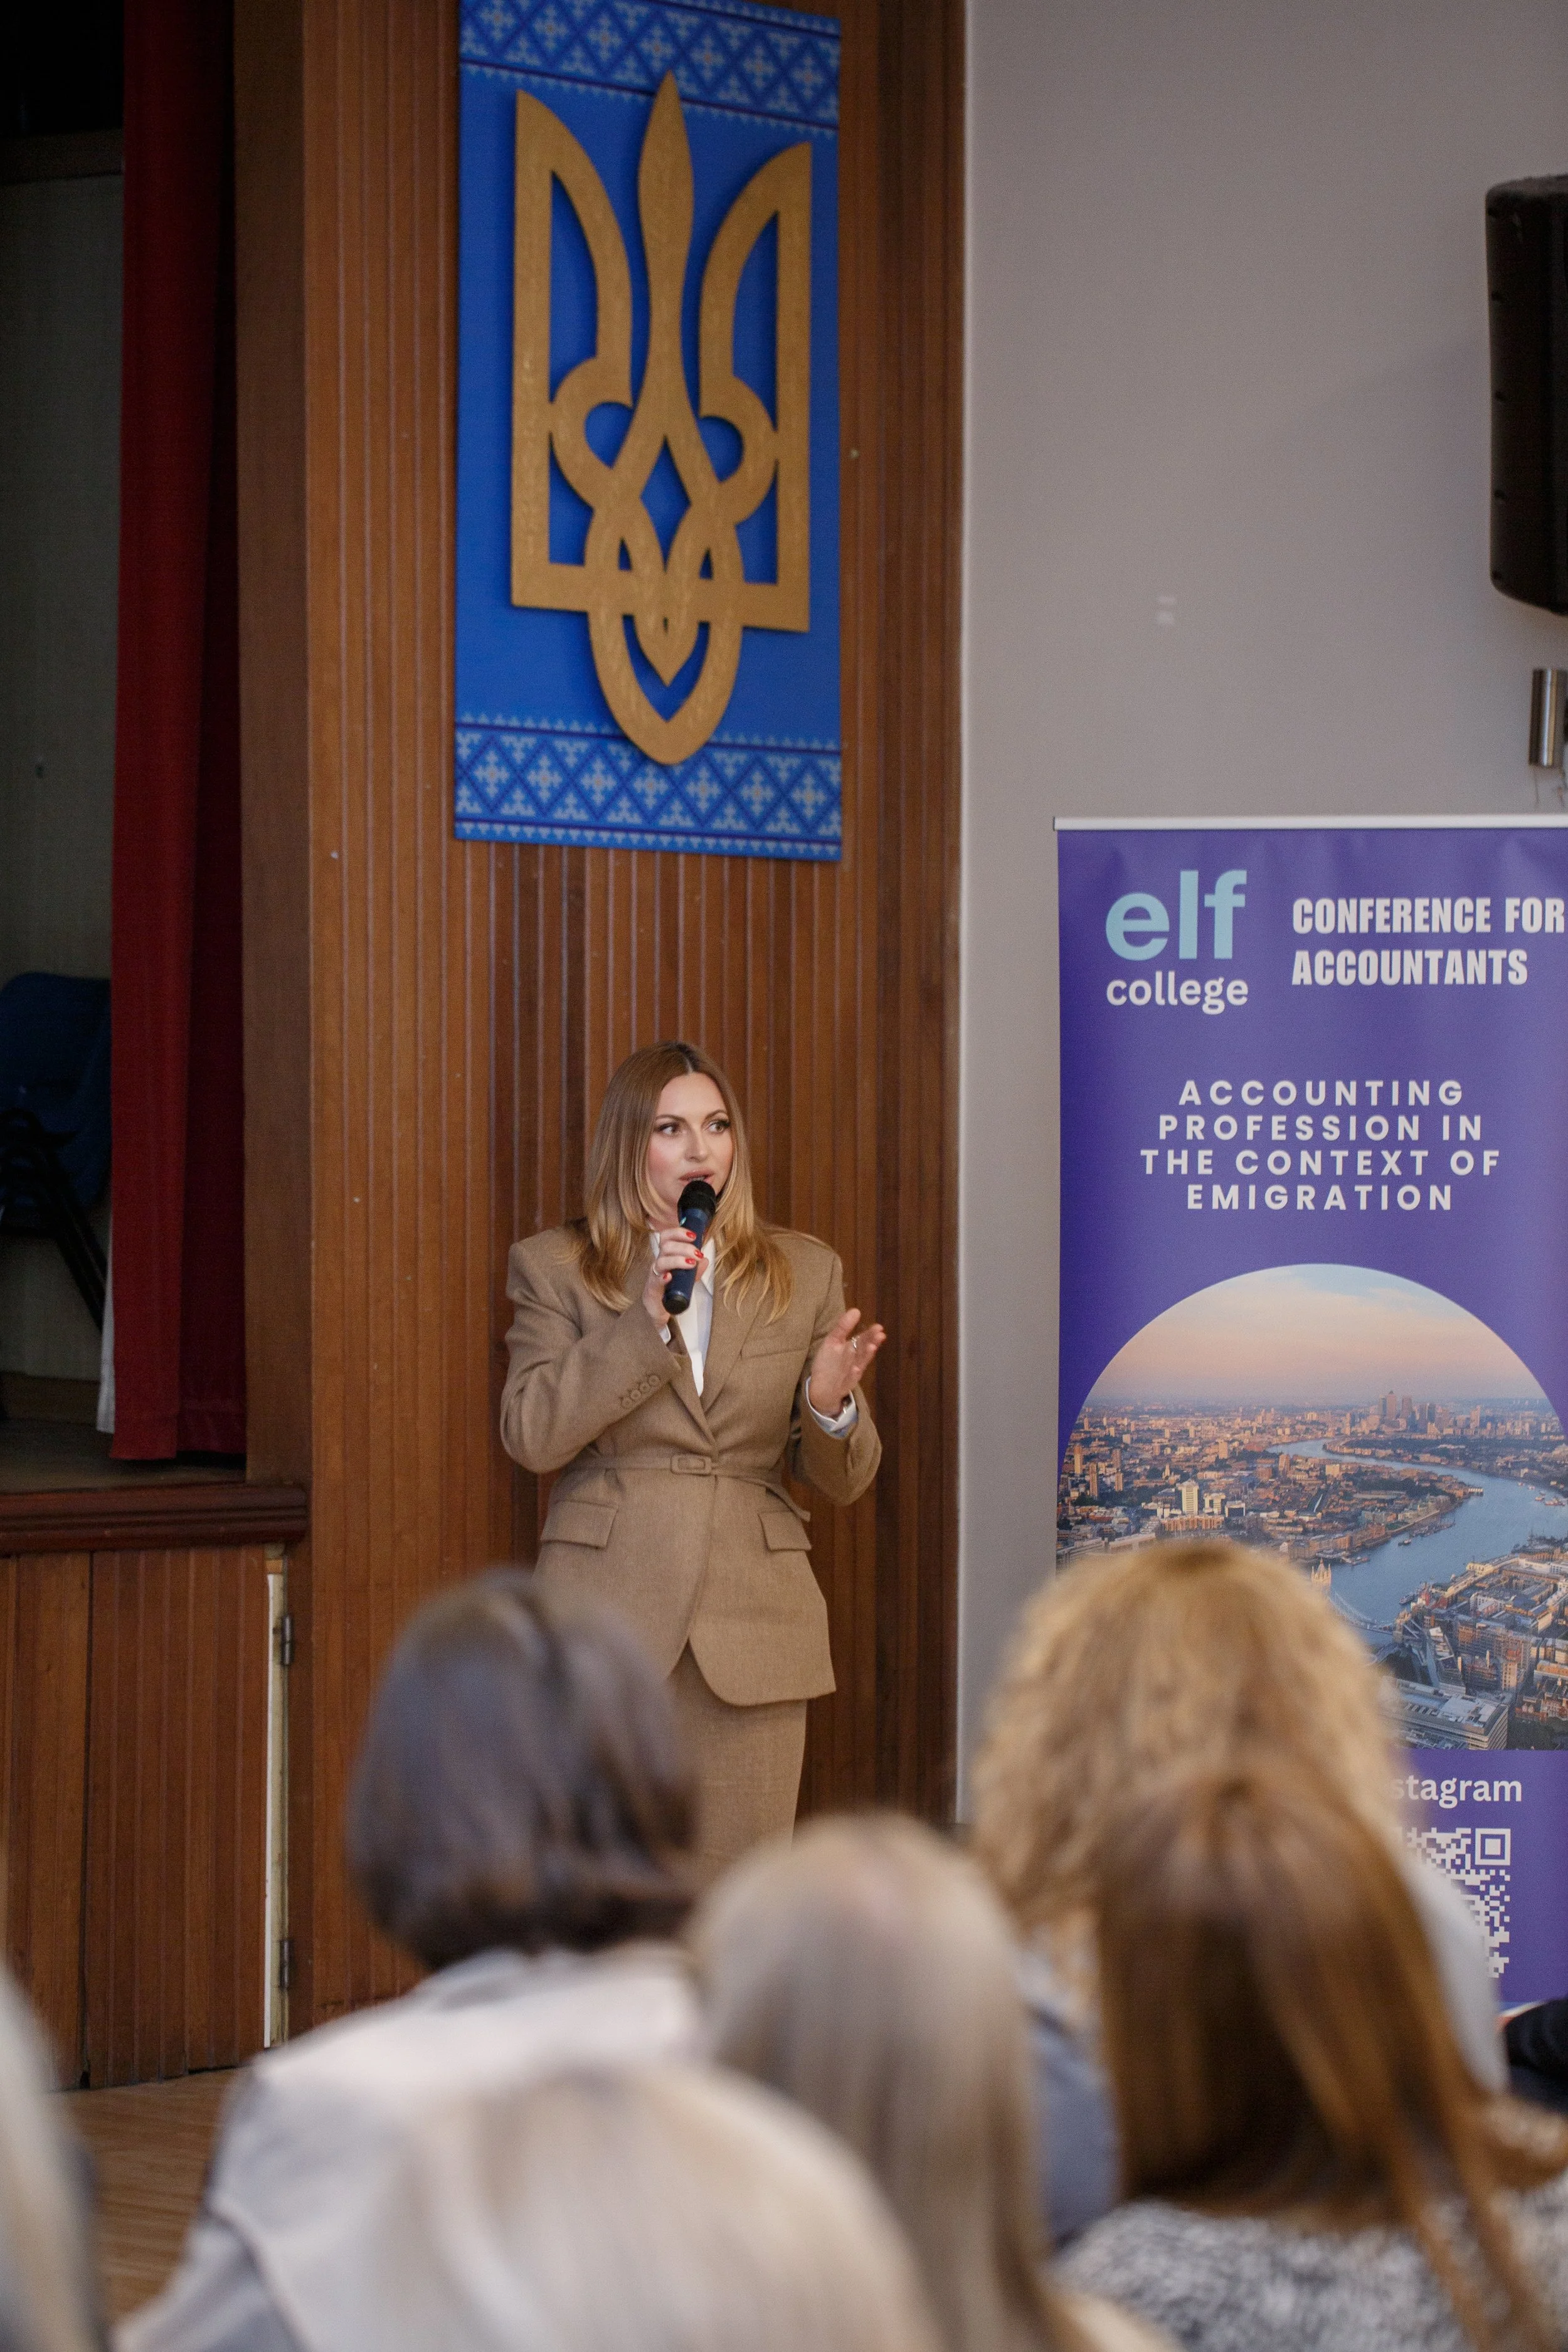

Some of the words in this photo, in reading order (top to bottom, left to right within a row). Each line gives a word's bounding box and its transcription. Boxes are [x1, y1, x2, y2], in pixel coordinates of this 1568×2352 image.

[1105, 869, 1248, 961] elf
[1292, 897, 1492, 934] CONFERENCE
[1505, 897, 1565, 933] FOR
[1291, 950, 1528, 986] ACCOUNTANTS
[1106, 970, 1249, 1015] college
[1179, 1080, 1464, 1106] ACCOUNTING
[1159, 1115, 1420, 1141] PROFESSION
[1443, 1115, 1482, 1140] IN
[1140, 1149, 1214, 1175] THE
[1236, 1150, 1429, 1175] CONTEXT
[1450, 1150, 1500, 1175] OF
[1187, 1184, 1453, 1210] EMIGRATION
[1390, 1774, 1522, 1809] stagram
